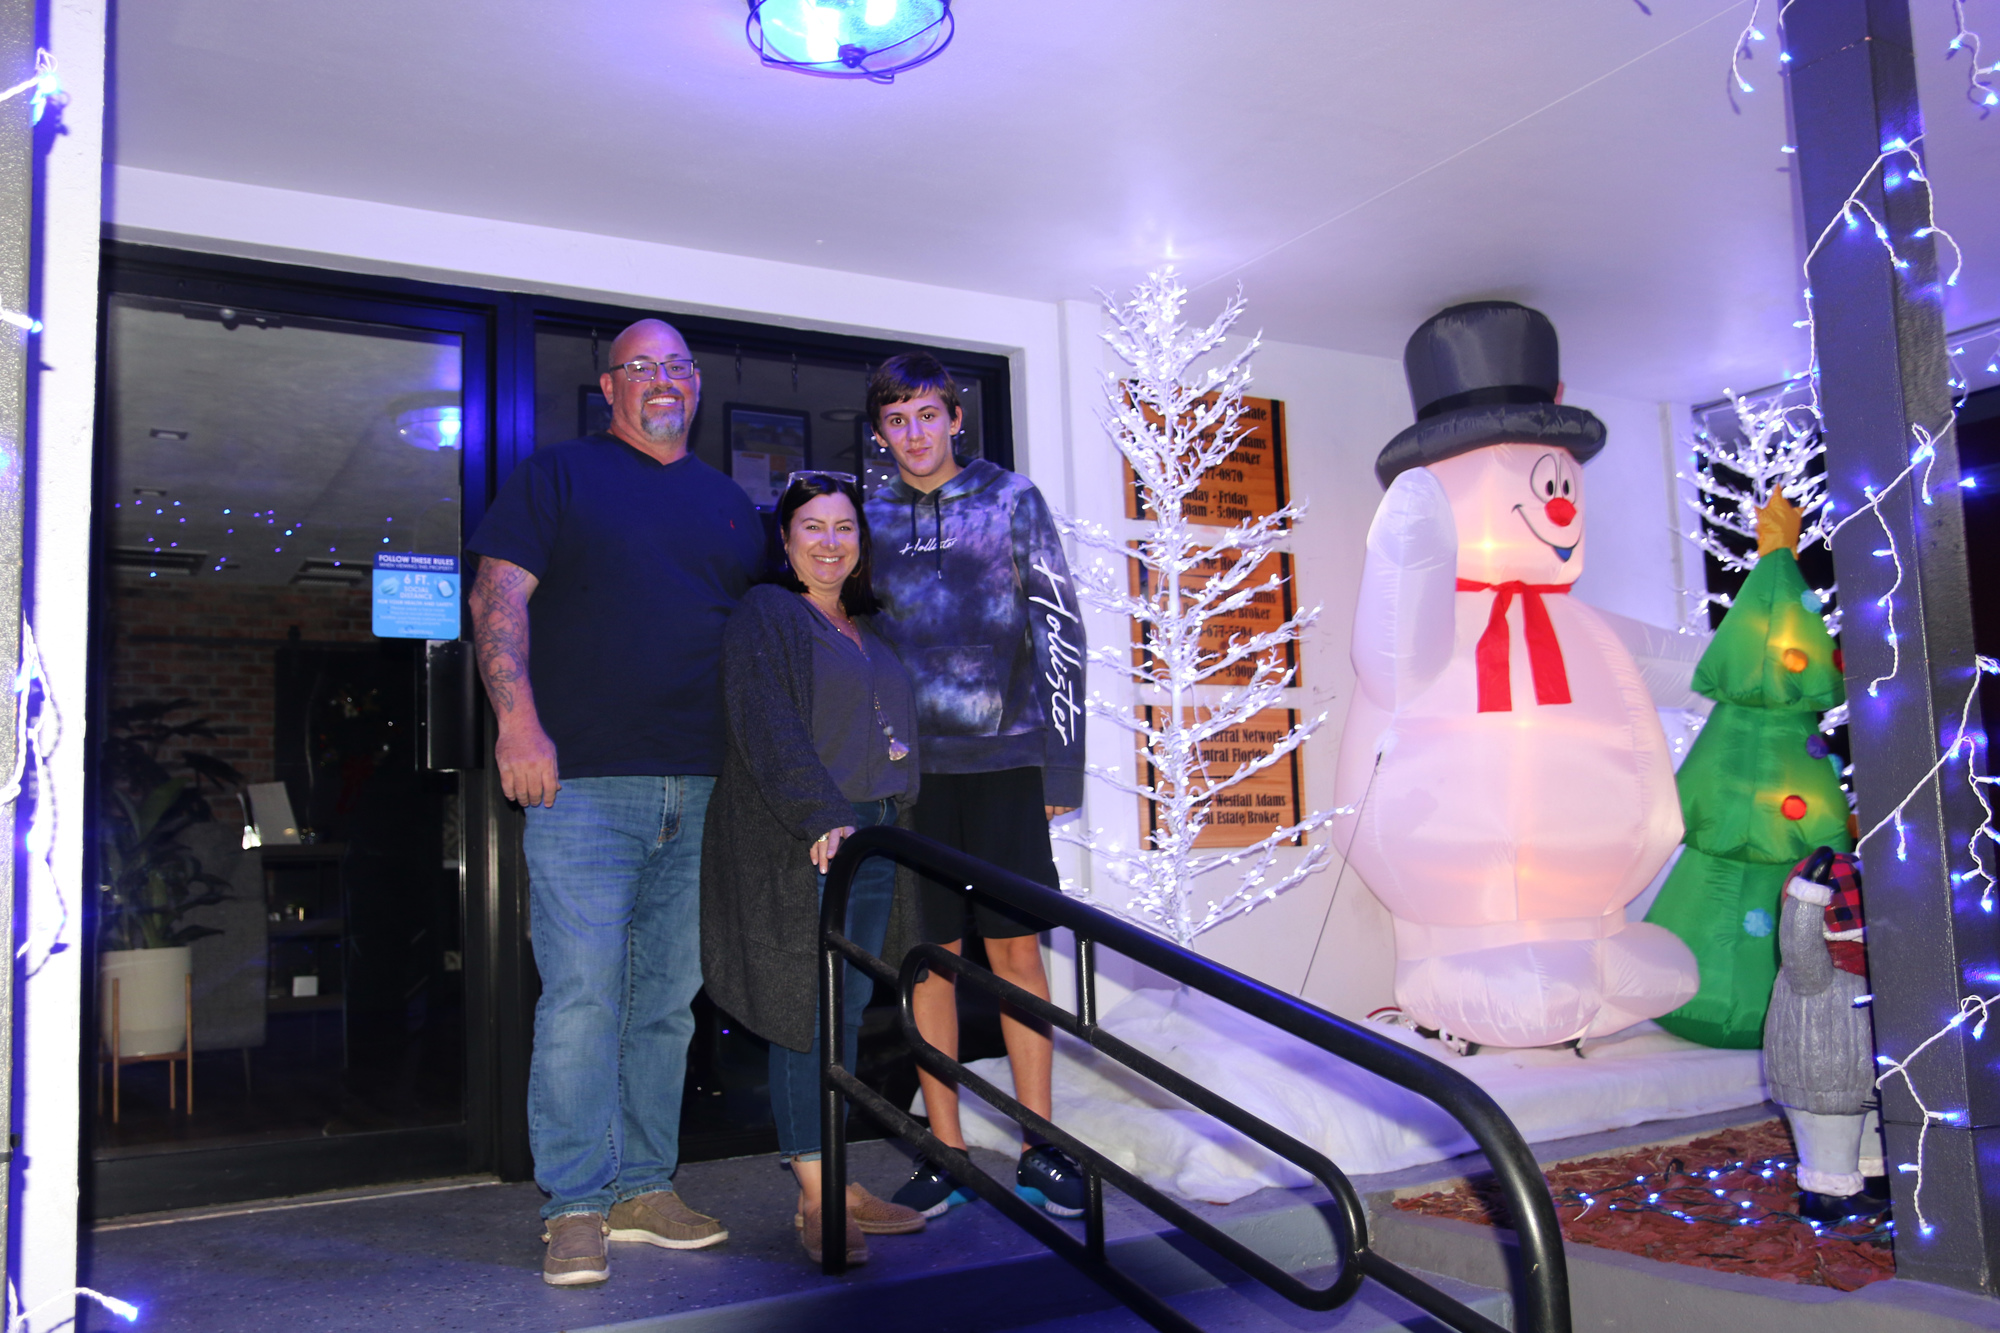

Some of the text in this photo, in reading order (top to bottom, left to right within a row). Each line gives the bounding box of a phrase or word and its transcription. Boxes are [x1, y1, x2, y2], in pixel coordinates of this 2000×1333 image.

[1228, 451, 1261, 465] Broker
[1218, 490, 1248, 508] Friday
[1217, 505, 1253, 522] 5:00pm
[899, 537, 958, 557] Holliter
[378, 554, 454, 566] FOLLOW THESE RULES
[403, 574, 430, 586] 6 FT.
[399, 592, 433, 600] DISTANCE
[1239, 606, 1271, 620] Broker
[1190, 623, 1252, 639] -677-5594
[1029, 557, 1082, 747] Hollister
[1255, 793, 1287, 808] Adams
[1216, 810, 1245, 825] Estate
[1247, 810, 1281, 825] Broker
